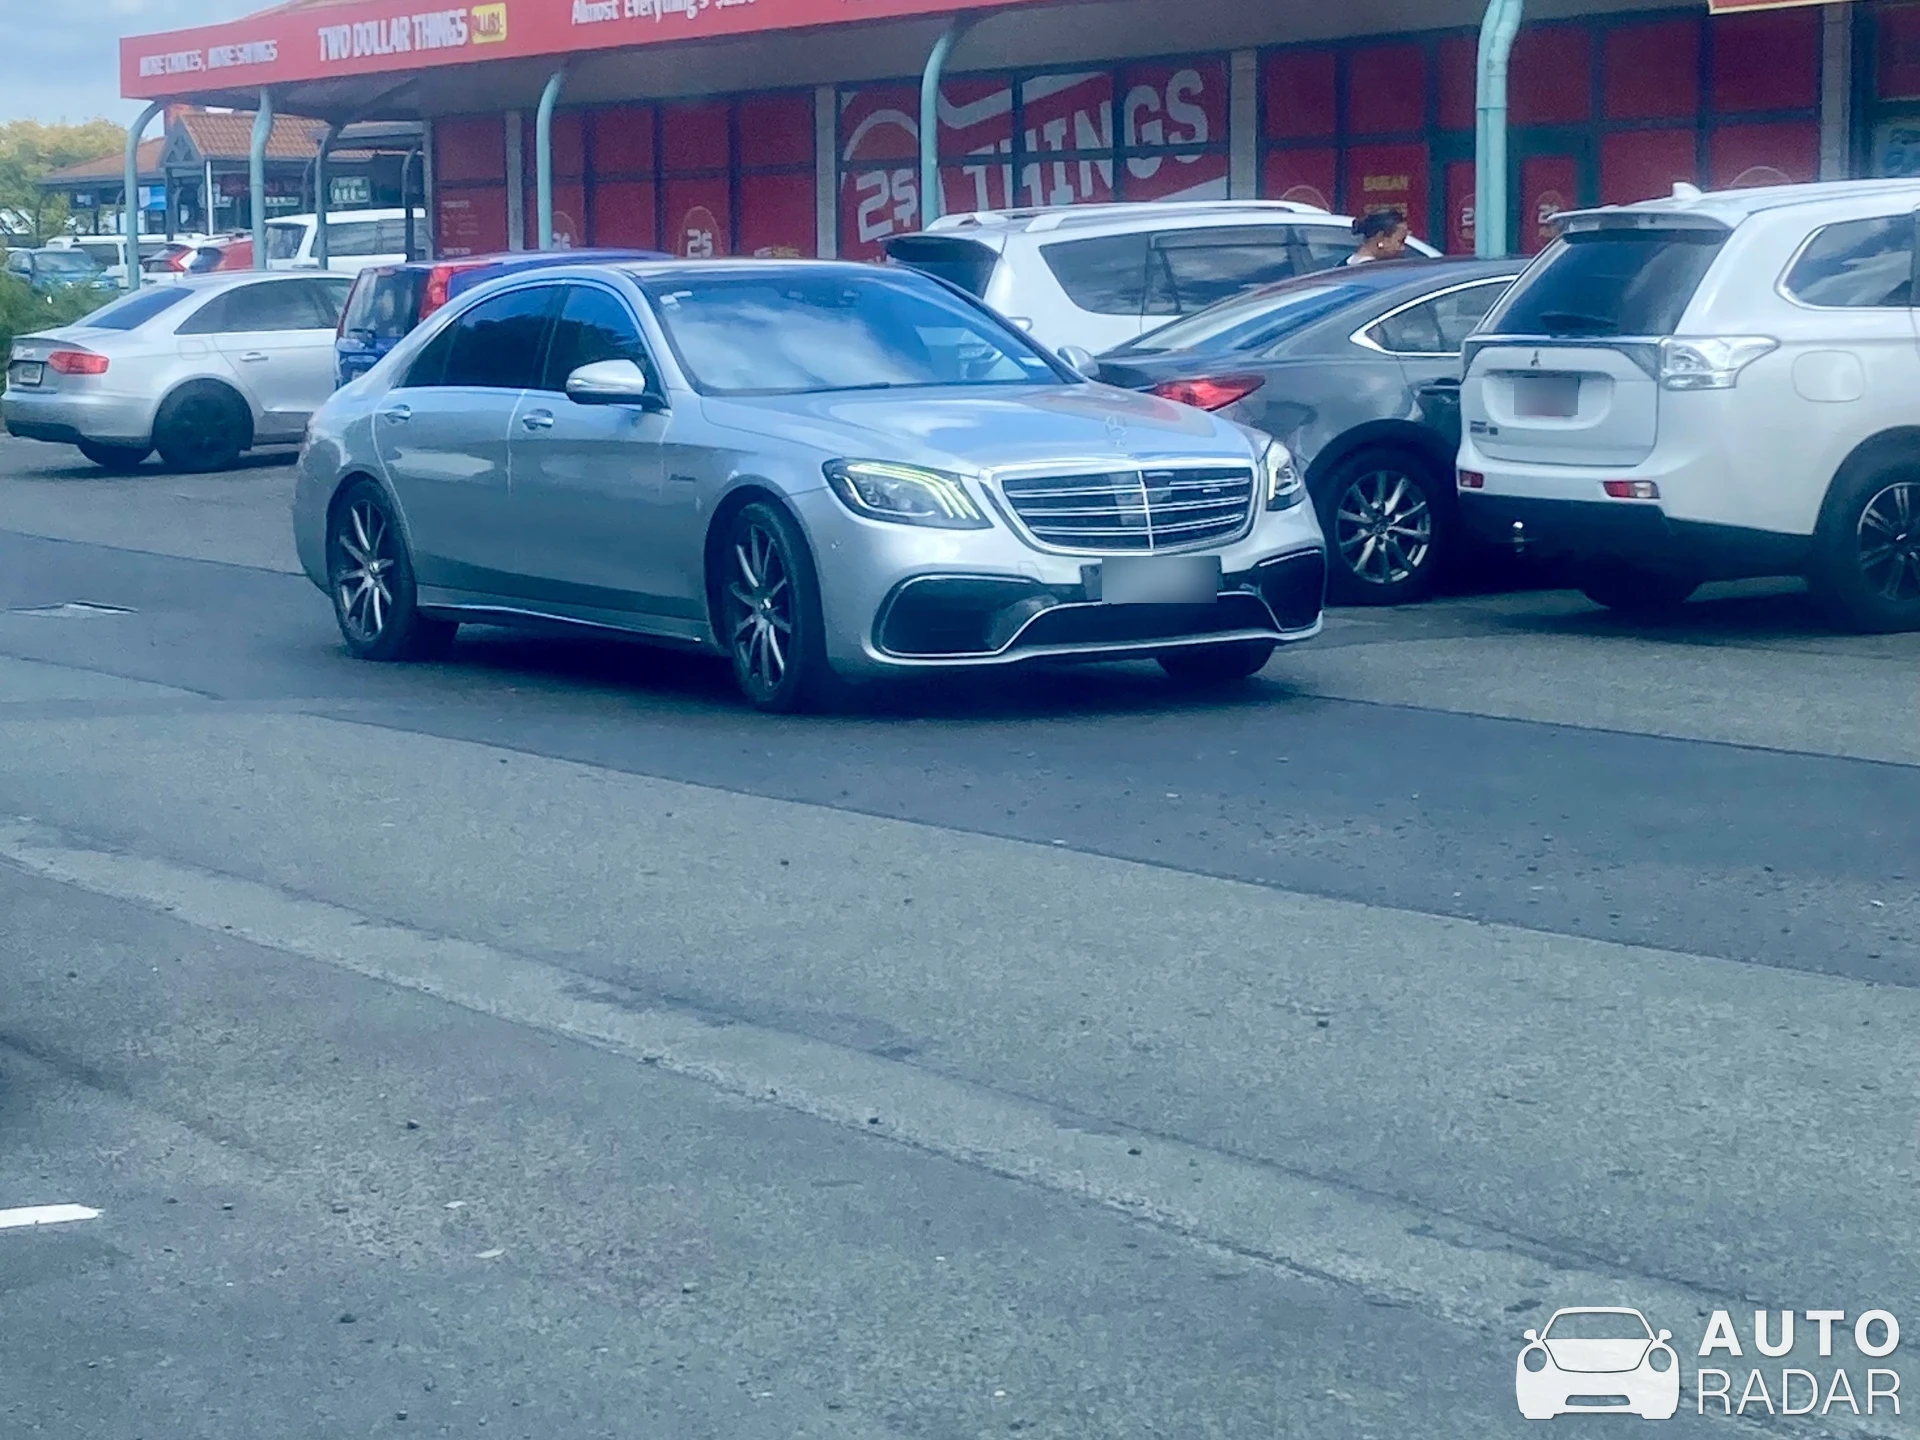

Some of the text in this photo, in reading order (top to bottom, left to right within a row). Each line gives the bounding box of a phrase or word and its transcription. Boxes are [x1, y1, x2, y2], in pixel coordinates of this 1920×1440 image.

[624, 0, 710, 23] Everythings
[318, 24, 351, 62] TWO
[352, 16, 412, 58] DOLLAR
[411, 8, 469, 51] THINGS
